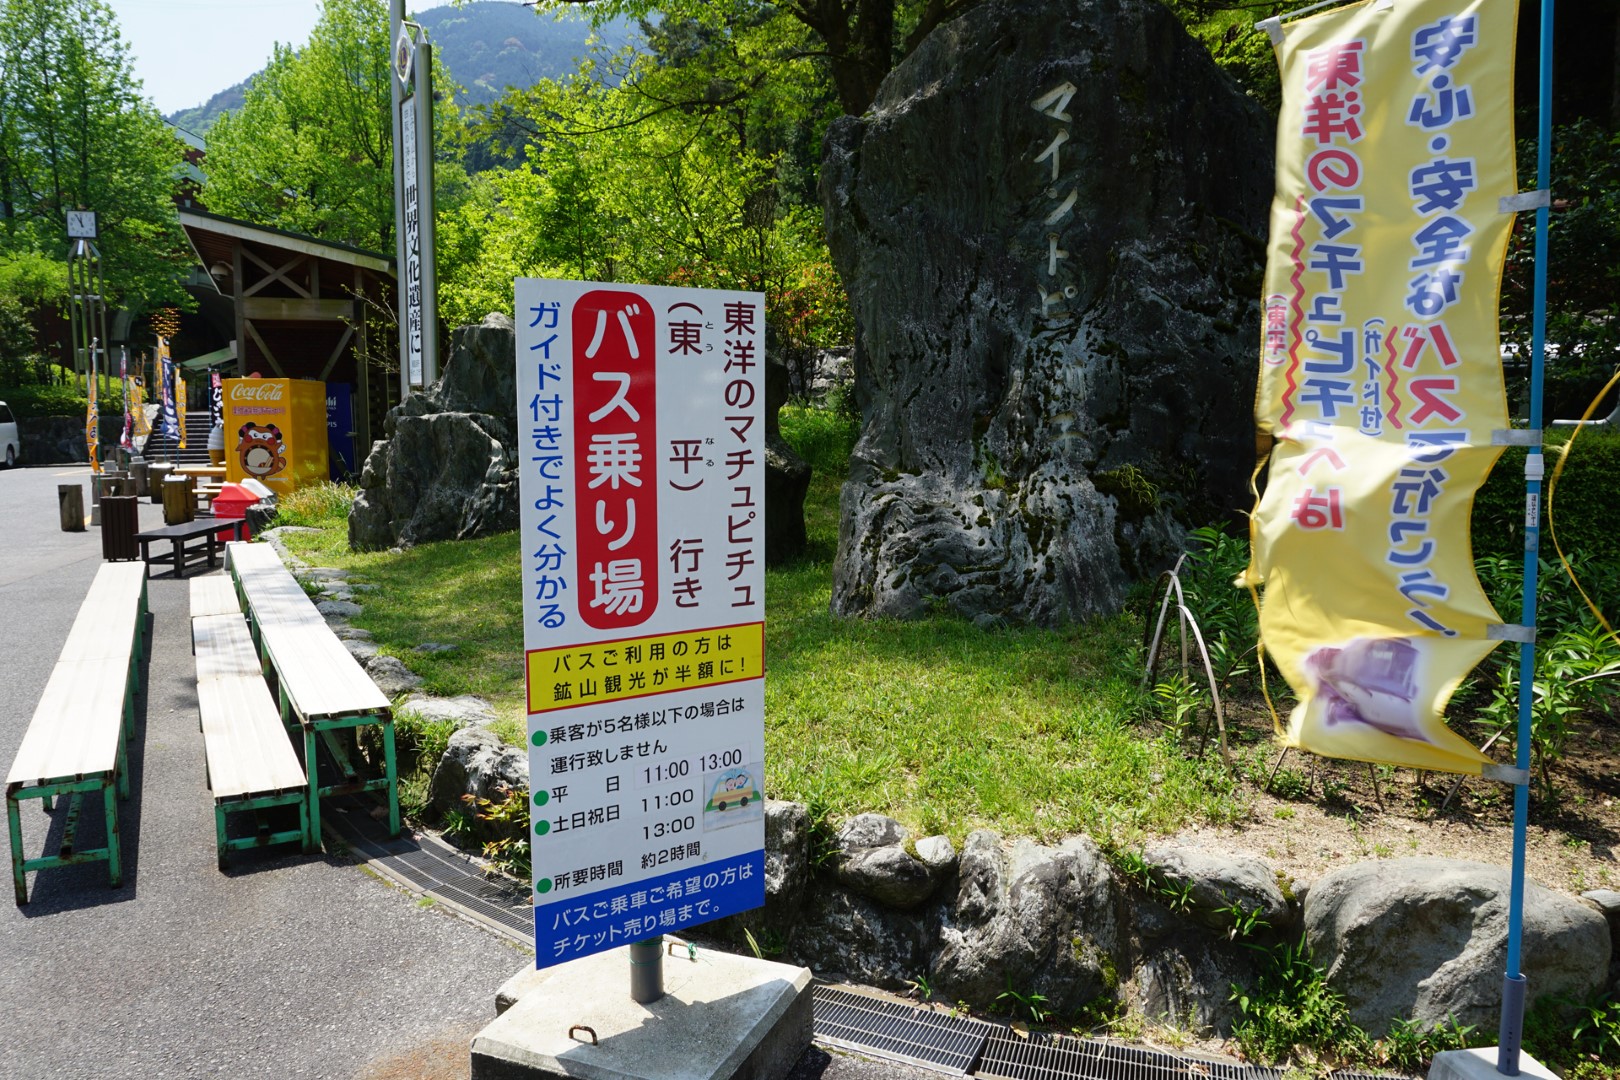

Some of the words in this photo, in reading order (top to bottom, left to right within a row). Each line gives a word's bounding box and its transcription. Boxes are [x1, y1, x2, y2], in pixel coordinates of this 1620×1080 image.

[405, 183, 422, 356] 世界文化遺産に
[529, 301, 568, 629] ガイド付きでよく分かる
[585, 303, 645, 616] バス乗り場
[723, 301, 757, 609] 東洋のマチュピチュ
[670, 538, 704, 609] 行き
[553, 634, 732, 674] バスご利用の方は
[553, 657, 746, 702] 鉱山観光が半額に！
[549, 697, 745, 745] 乗客が5名様以下の場合は
[550, 739, 668, 776] 運行致しません
[644, 760, 690, 785] 11:00
[699, 749, 743, 773] 13:00
[552, 804, 621, 835] 土日祝日
[641, 788, 695, 813] 11:00
[642, 815, 695, 840] 13:00
[553, 860, 624, 892] 所要時間
[641, 841, 701, 870] 約2時間
[553, 862, 754, 931] バスご乗車ご希望の方は
[553, 902, 721, 957] チケット売り場まで。
